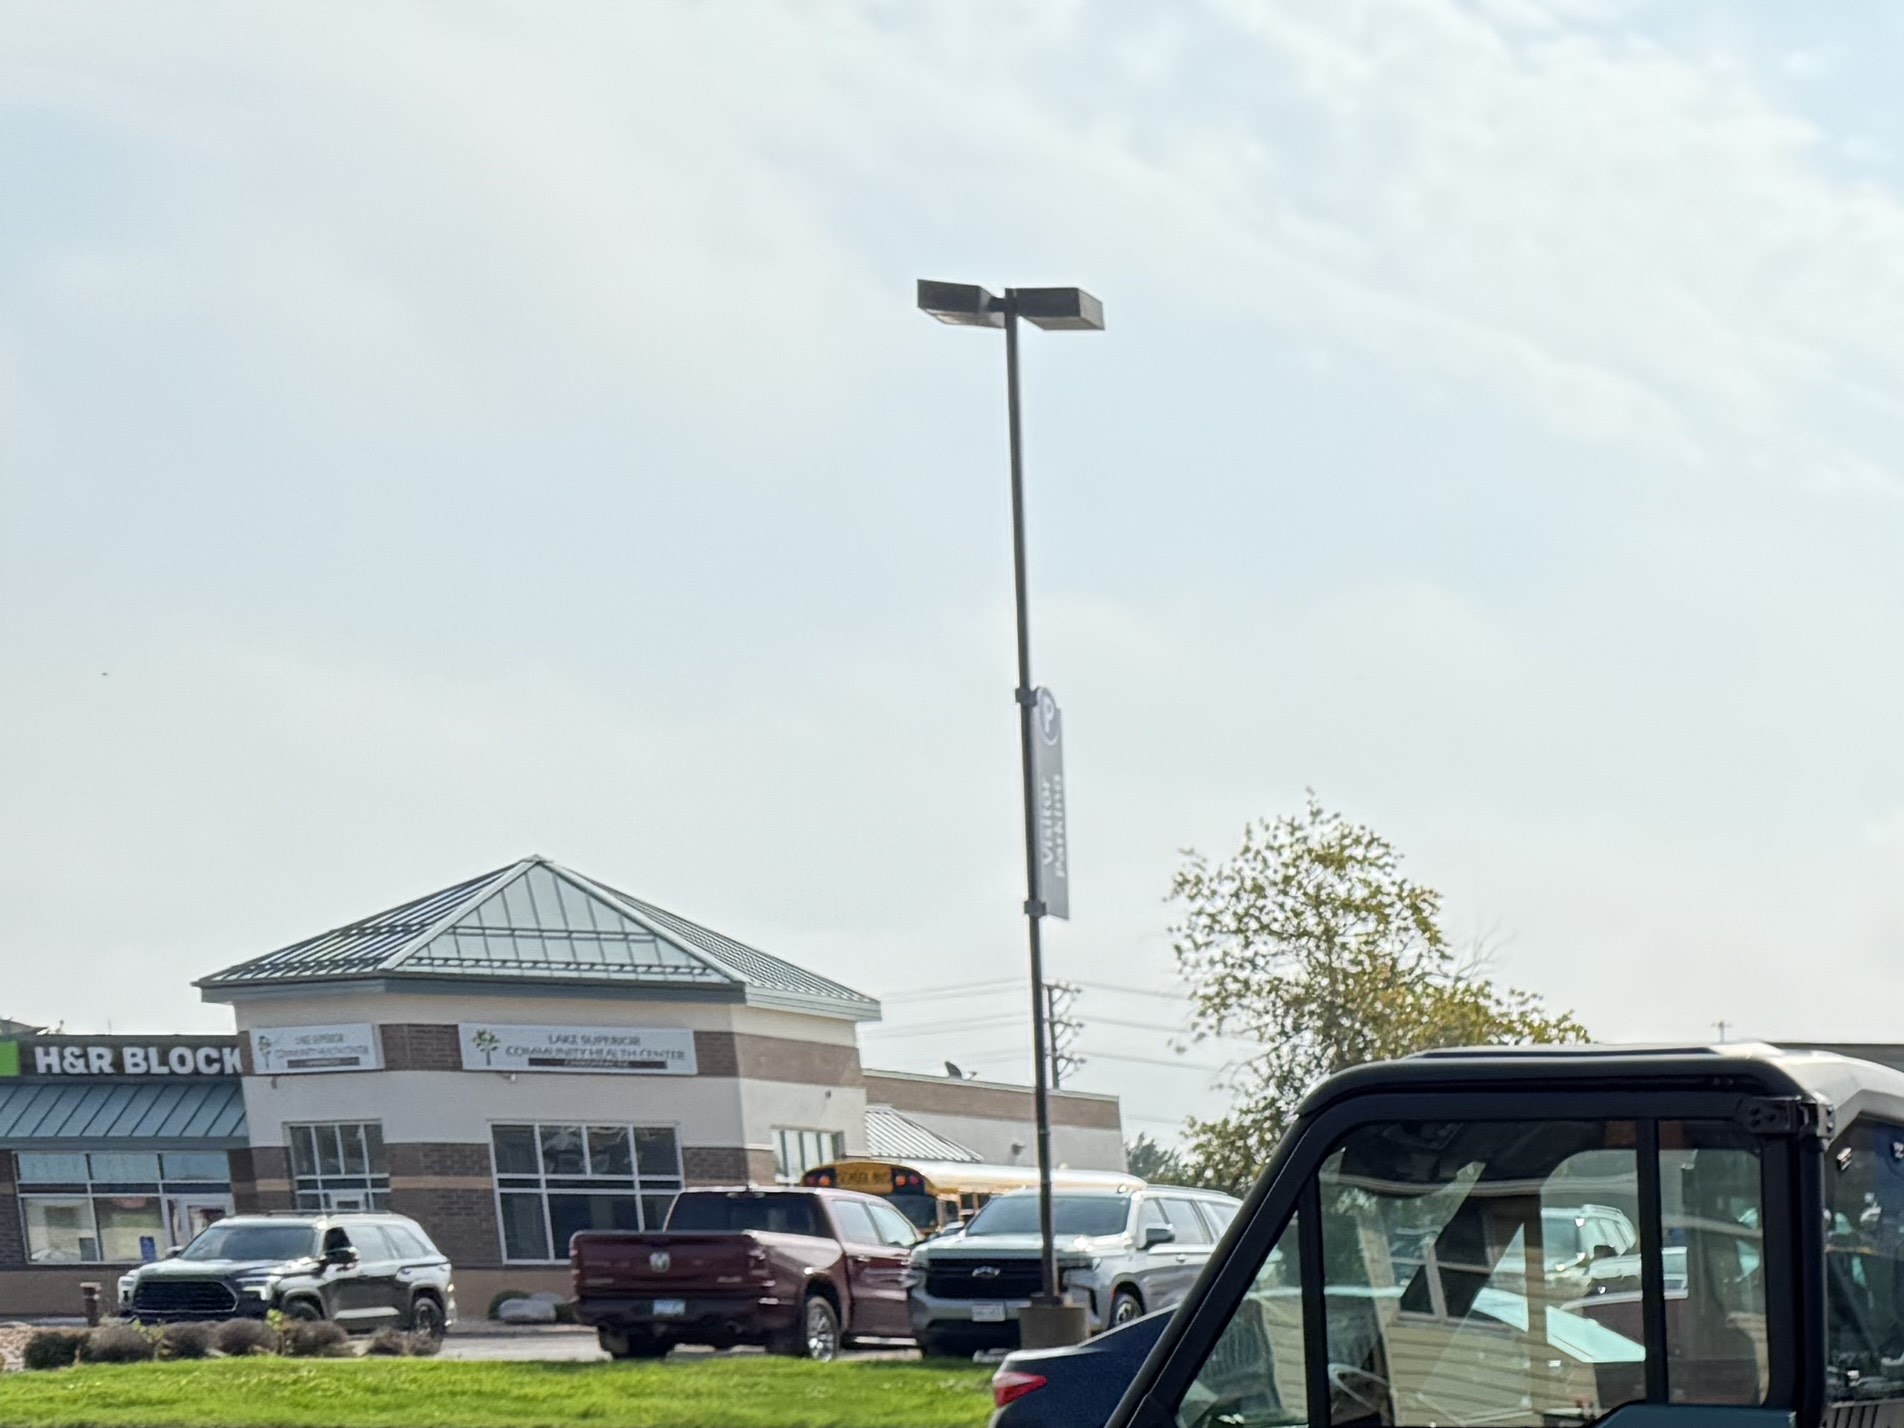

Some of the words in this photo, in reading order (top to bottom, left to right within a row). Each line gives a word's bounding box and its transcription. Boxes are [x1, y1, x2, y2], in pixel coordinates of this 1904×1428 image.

[580, 1035, 641, 1046] SUPERIOR
[35, 1046, 114, 1075] H&R
[122, 1046, 243, 1075] BLOCK
